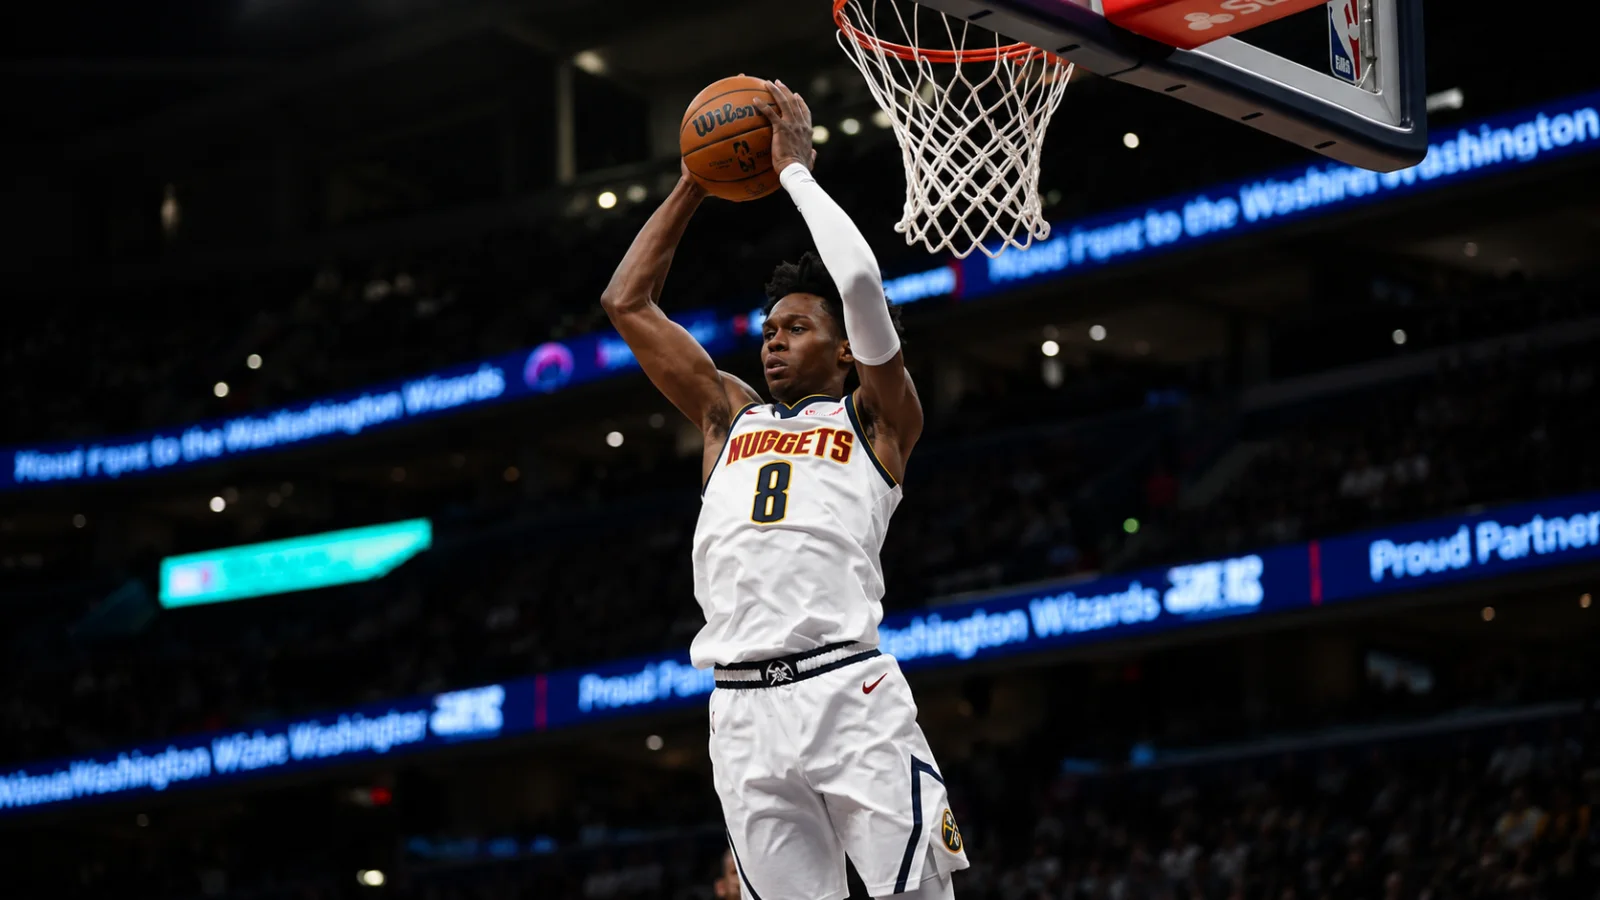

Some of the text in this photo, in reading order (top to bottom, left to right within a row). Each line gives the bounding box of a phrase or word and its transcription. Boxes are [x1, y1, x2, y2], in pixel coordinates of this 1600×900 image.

[726, 427, 854, 467] NUGGETS
[751, 459, 794, 526] 8
[1370, 526, 1470, 581] Proud
[880, 609, 1028, 659] ashington
[1030, 581, 1160, 637] Wizards
